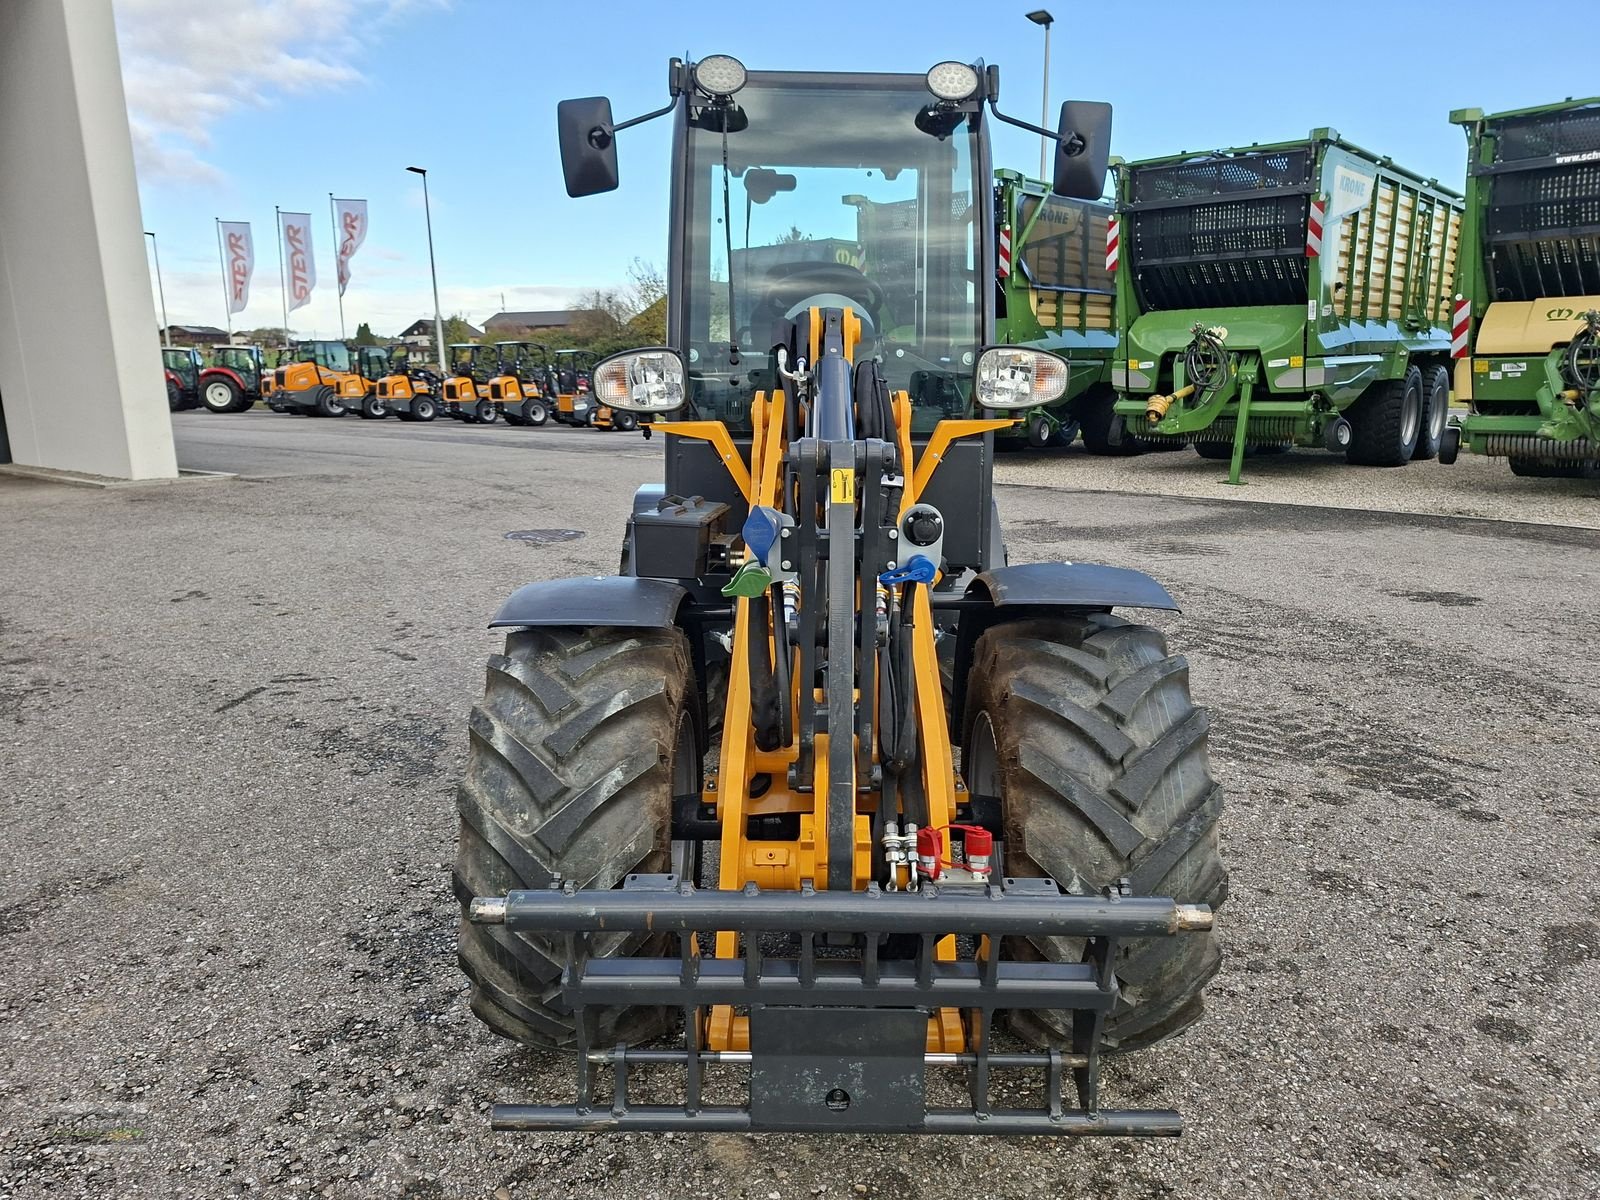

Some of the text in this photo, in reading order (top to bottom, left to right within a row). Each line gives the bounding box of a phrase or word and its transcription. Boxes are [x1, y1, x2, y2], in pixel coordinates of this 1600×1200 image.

[1555, 150, 1600, 164] www.sch
[1339, 174, 1366, 197] KRONE
[1036, 206, 1070, 225] RONE
[228, 232, 247, 301] STEYR
[286, 224, 308, 301] STEYR
